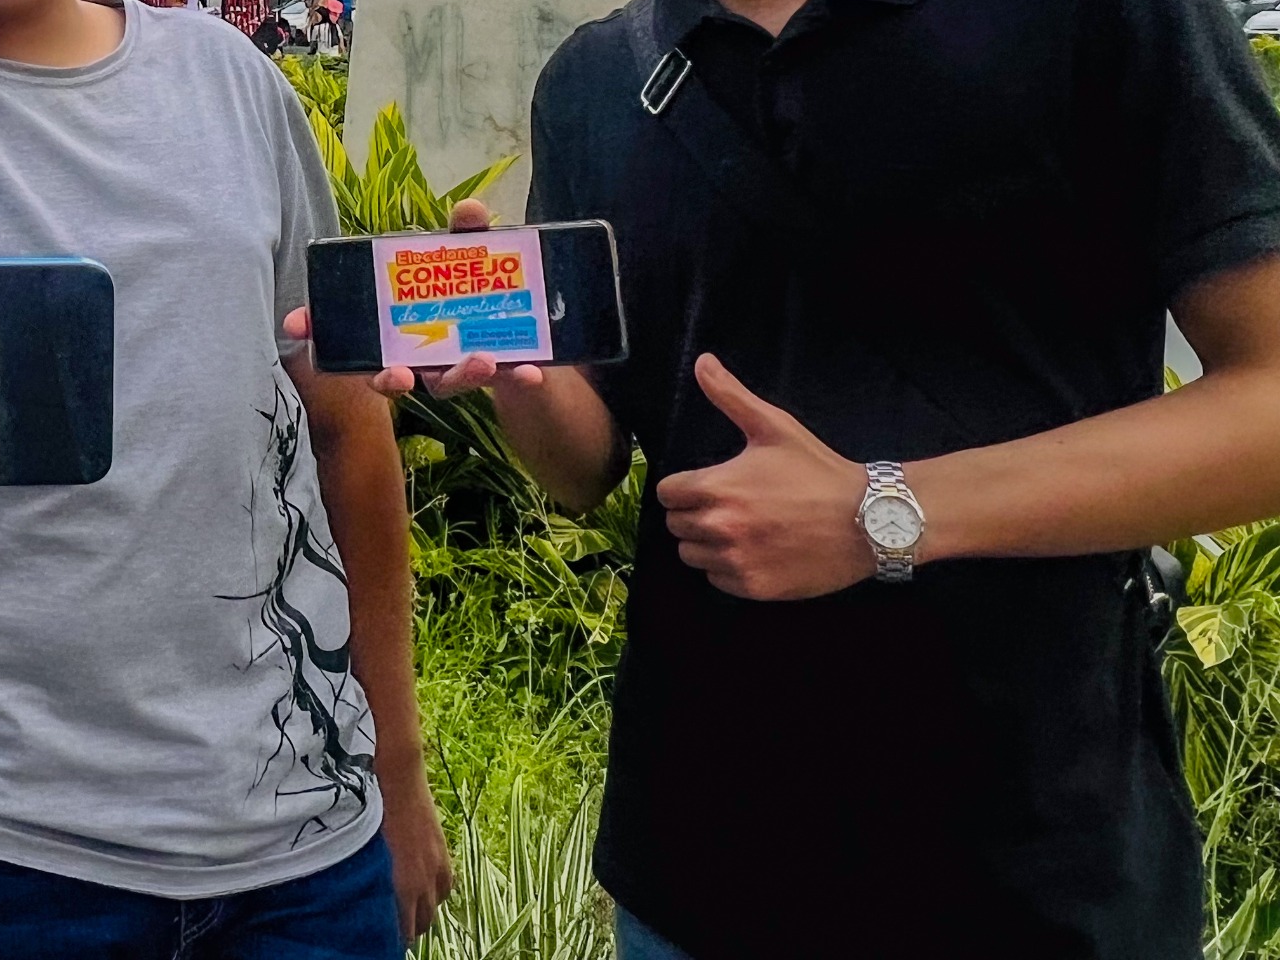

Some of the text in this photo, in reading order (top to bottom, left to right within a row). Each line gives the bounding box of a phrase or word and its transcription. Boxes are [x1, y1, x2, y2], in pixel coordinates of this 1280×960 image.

[396, 245, 488, 266] Elecciones
[396, 257, 519, 286] CONSEJO
[397, 275, 519, 302] MUNICIPAL
